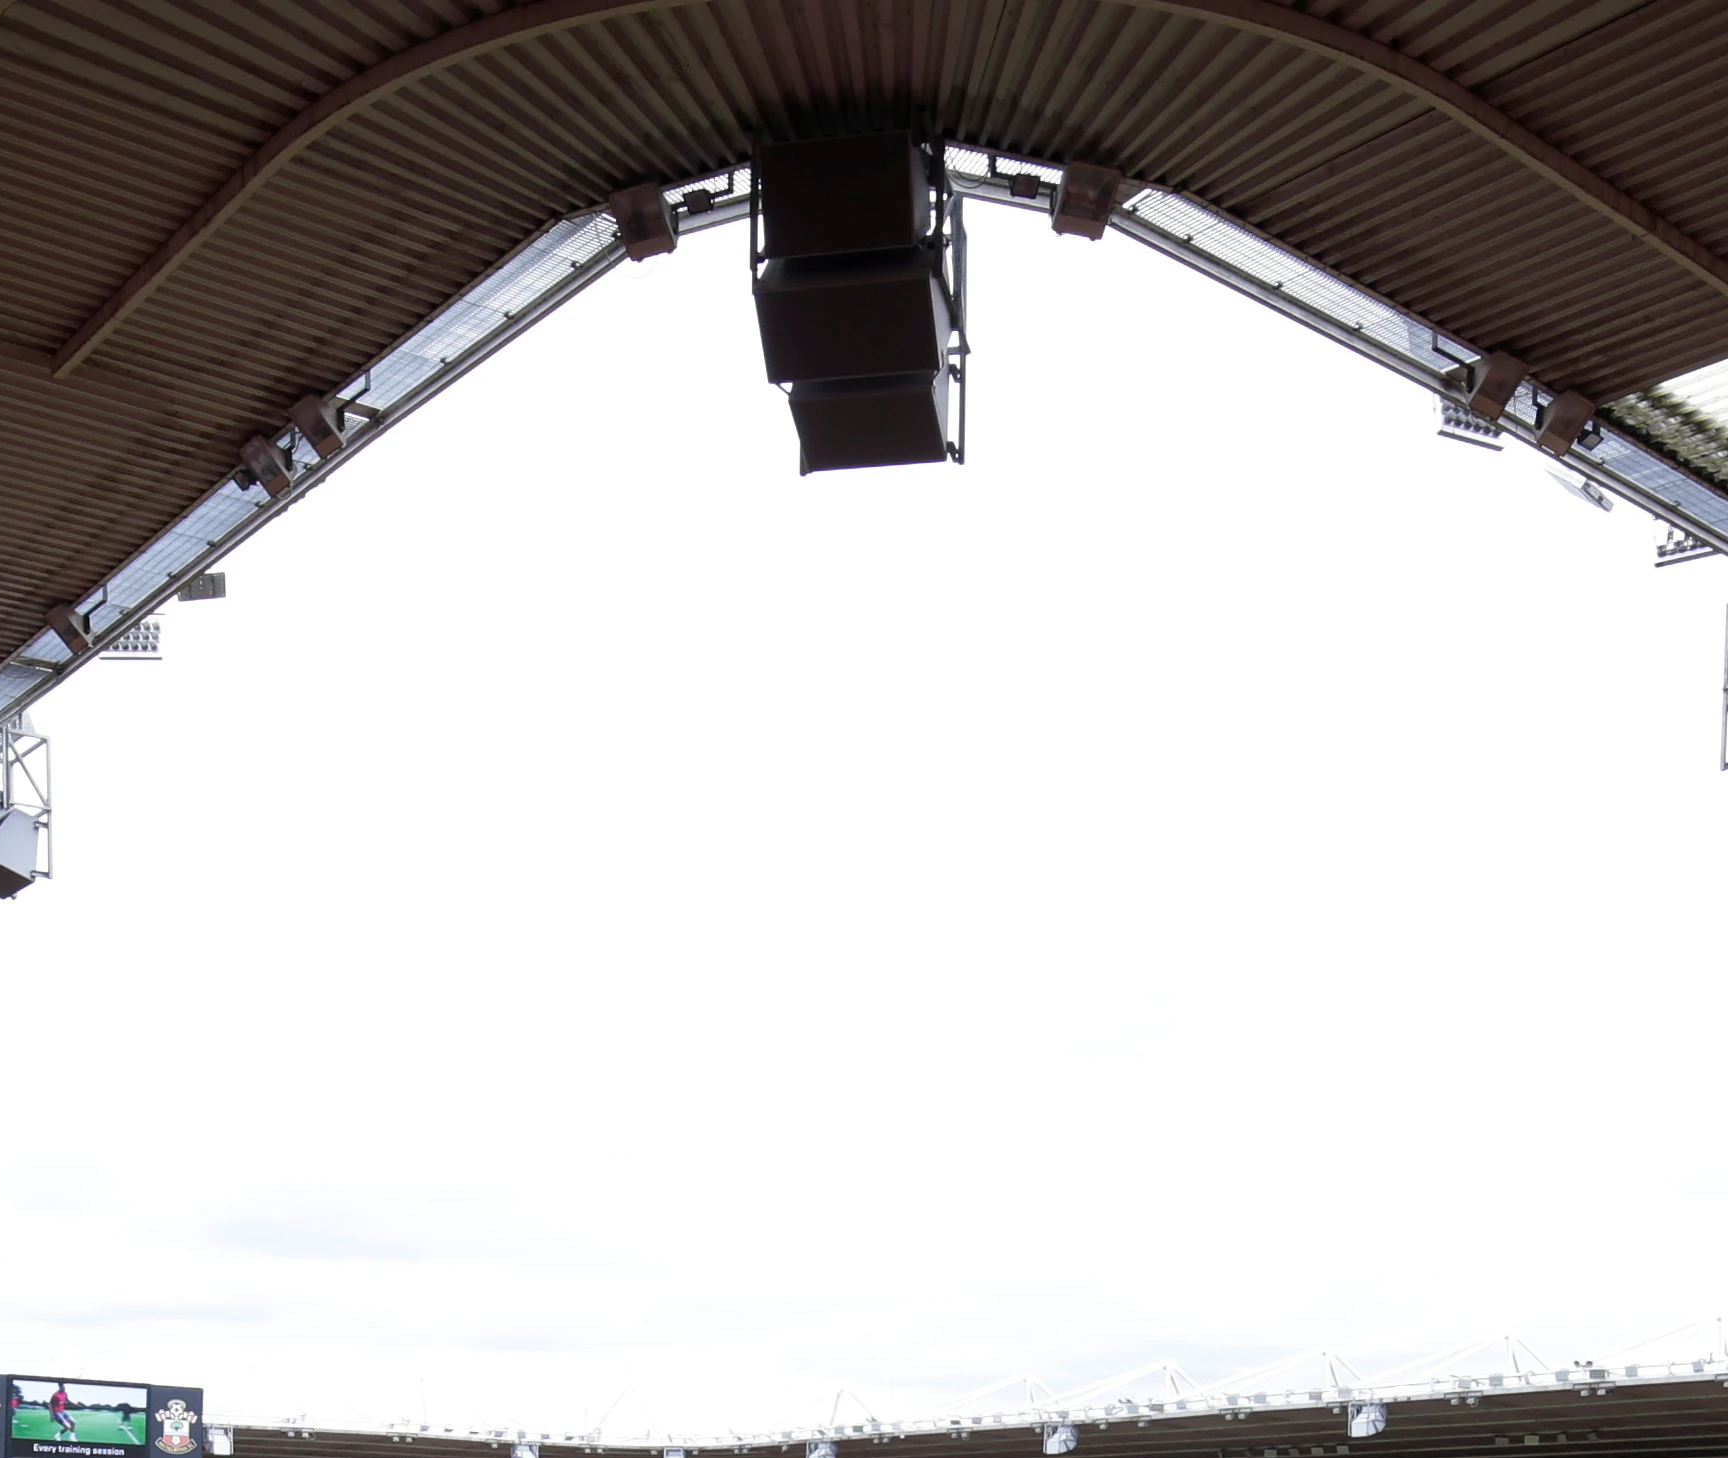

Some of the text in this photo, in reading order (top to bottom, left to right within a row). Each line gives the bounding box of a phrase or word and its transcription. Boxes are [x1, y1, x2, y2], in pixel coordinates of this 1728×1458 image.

[33, 1443, 125, 1456] Every training session
